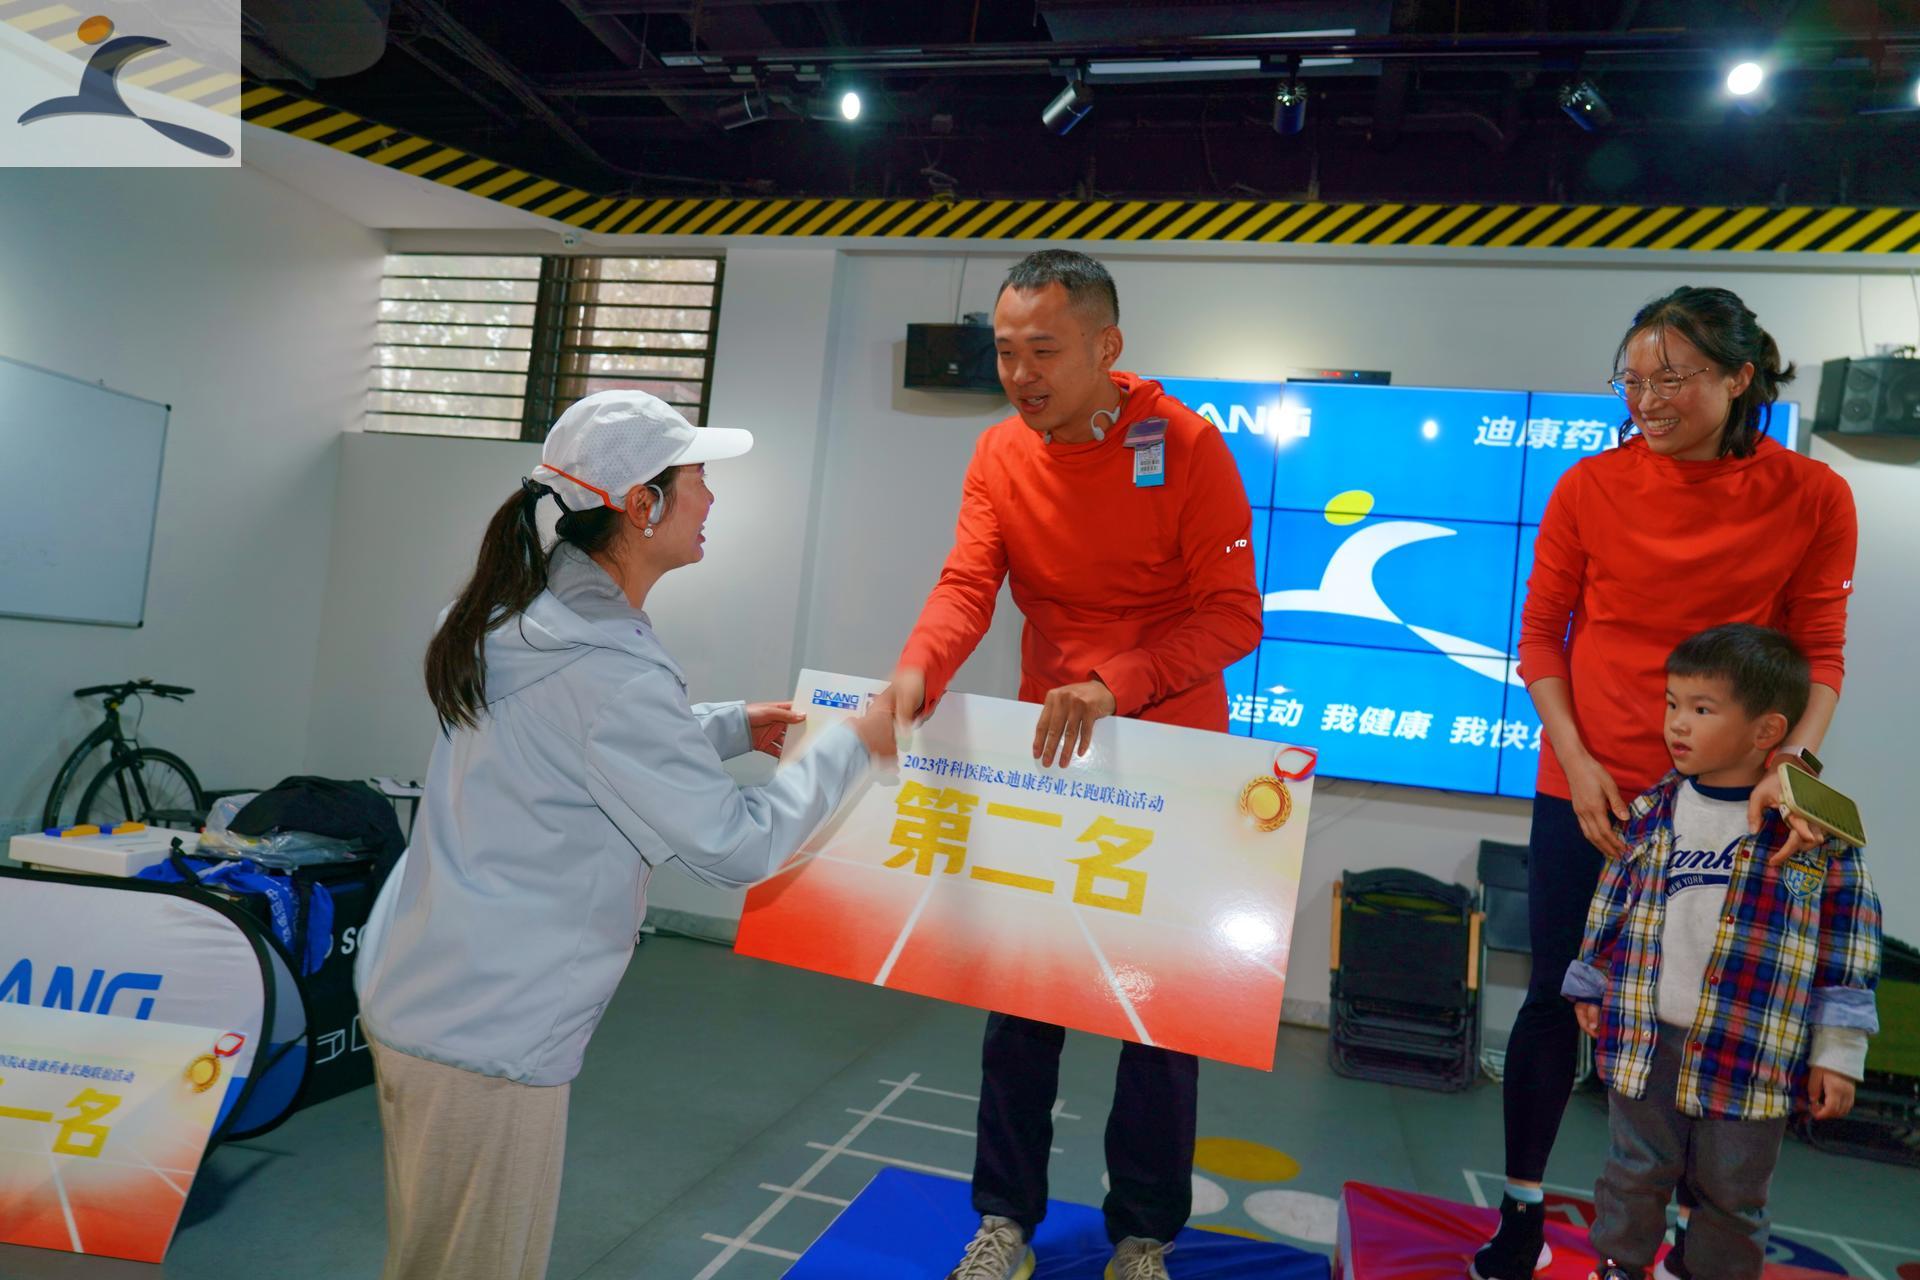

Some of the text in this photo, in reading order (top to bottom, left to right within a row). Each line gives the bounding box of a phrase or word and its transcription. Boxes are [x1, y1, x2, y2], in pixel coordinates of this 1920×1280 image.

[1183, 401, 1312, 438] ANG
[813, 689, 859, 705] DIKANG
[1227, 694, 1304, 727] 运动
[1320, 703, 1434, 740] 我健康
[903, 755, 1165, 813] 2023骨科医院&迪康药业长跑联谊活动
[881, 779, 1155, 916] 第二名
[1682, 874, 1704, 887] YORK
[0, 1075, 122, 1158] 一名
